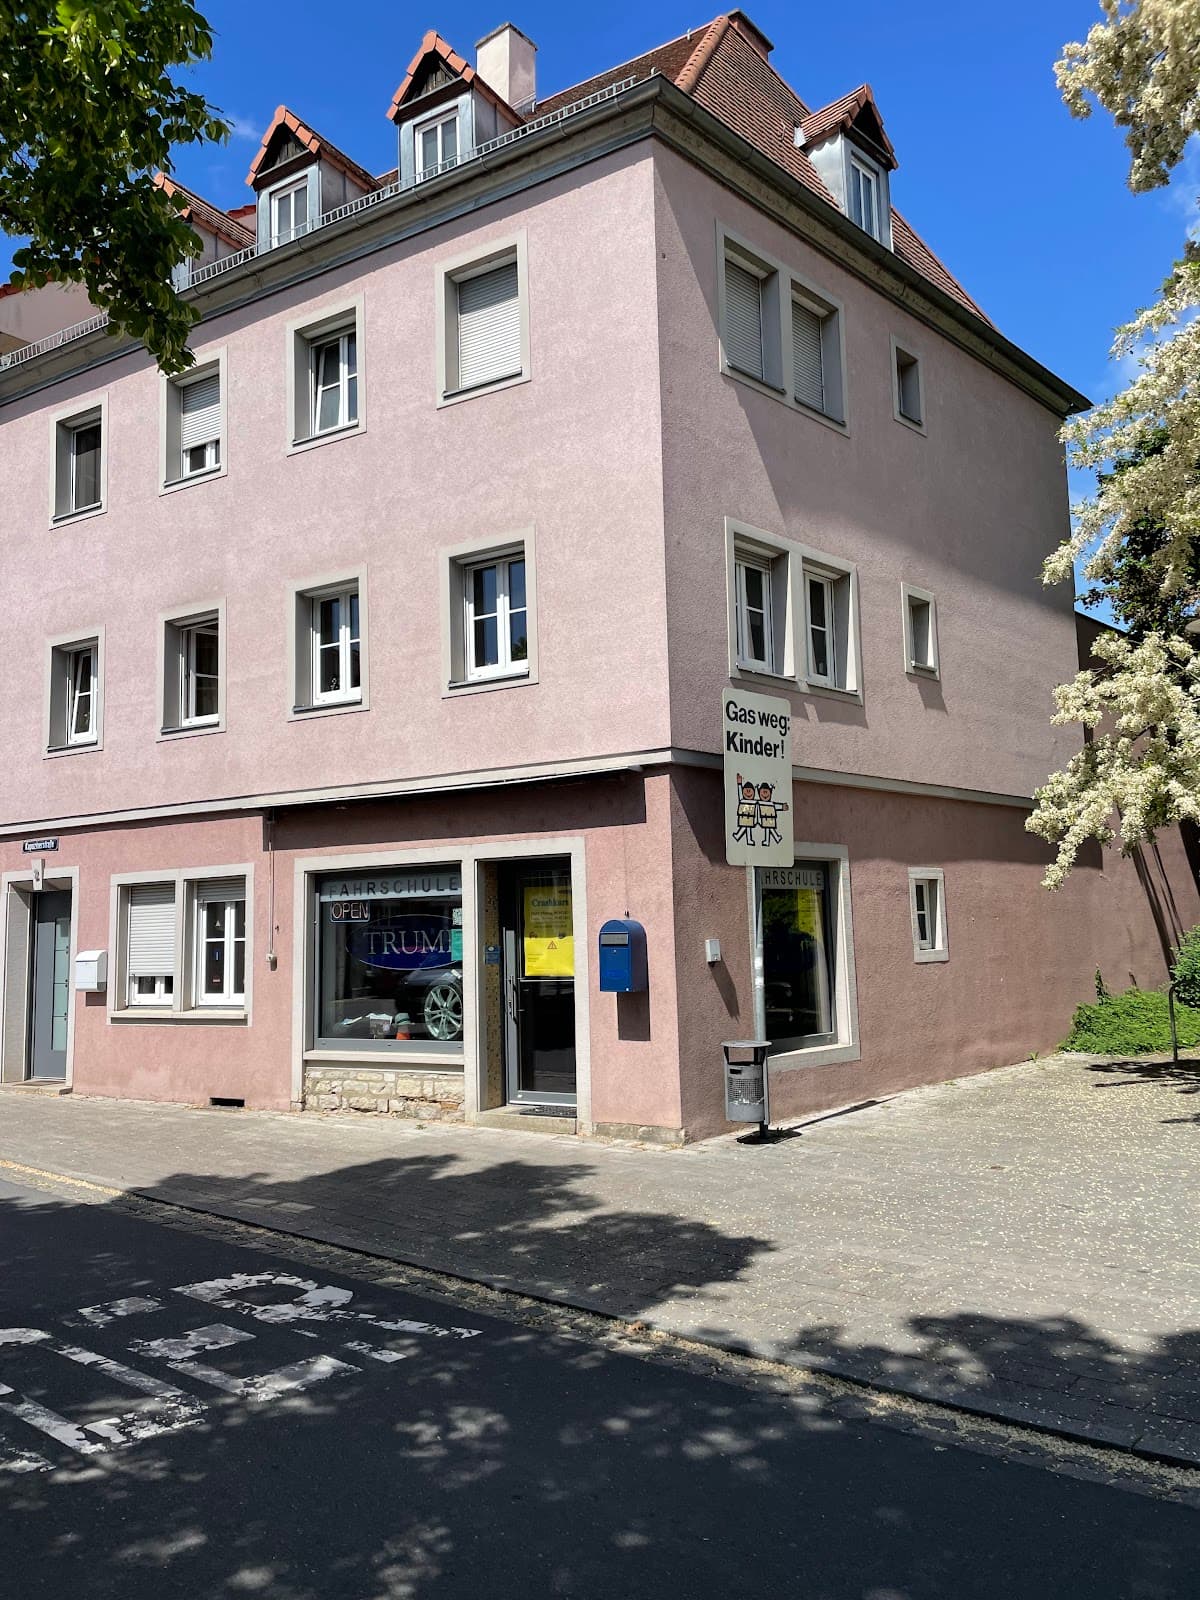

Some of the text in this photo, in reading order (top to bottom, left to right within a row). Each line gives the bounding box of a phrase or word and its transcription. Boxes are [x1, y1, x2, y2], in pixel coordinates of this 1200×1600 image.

[726, 700, 791, 737] Gas weg:
[726, 731, 785, 759] Kinder!
[328, 877, 459, 898] FAHRSCHULE
[762, 870, 824, 886] HRSCHULE
[331, 902, 370, 920] OPEN
